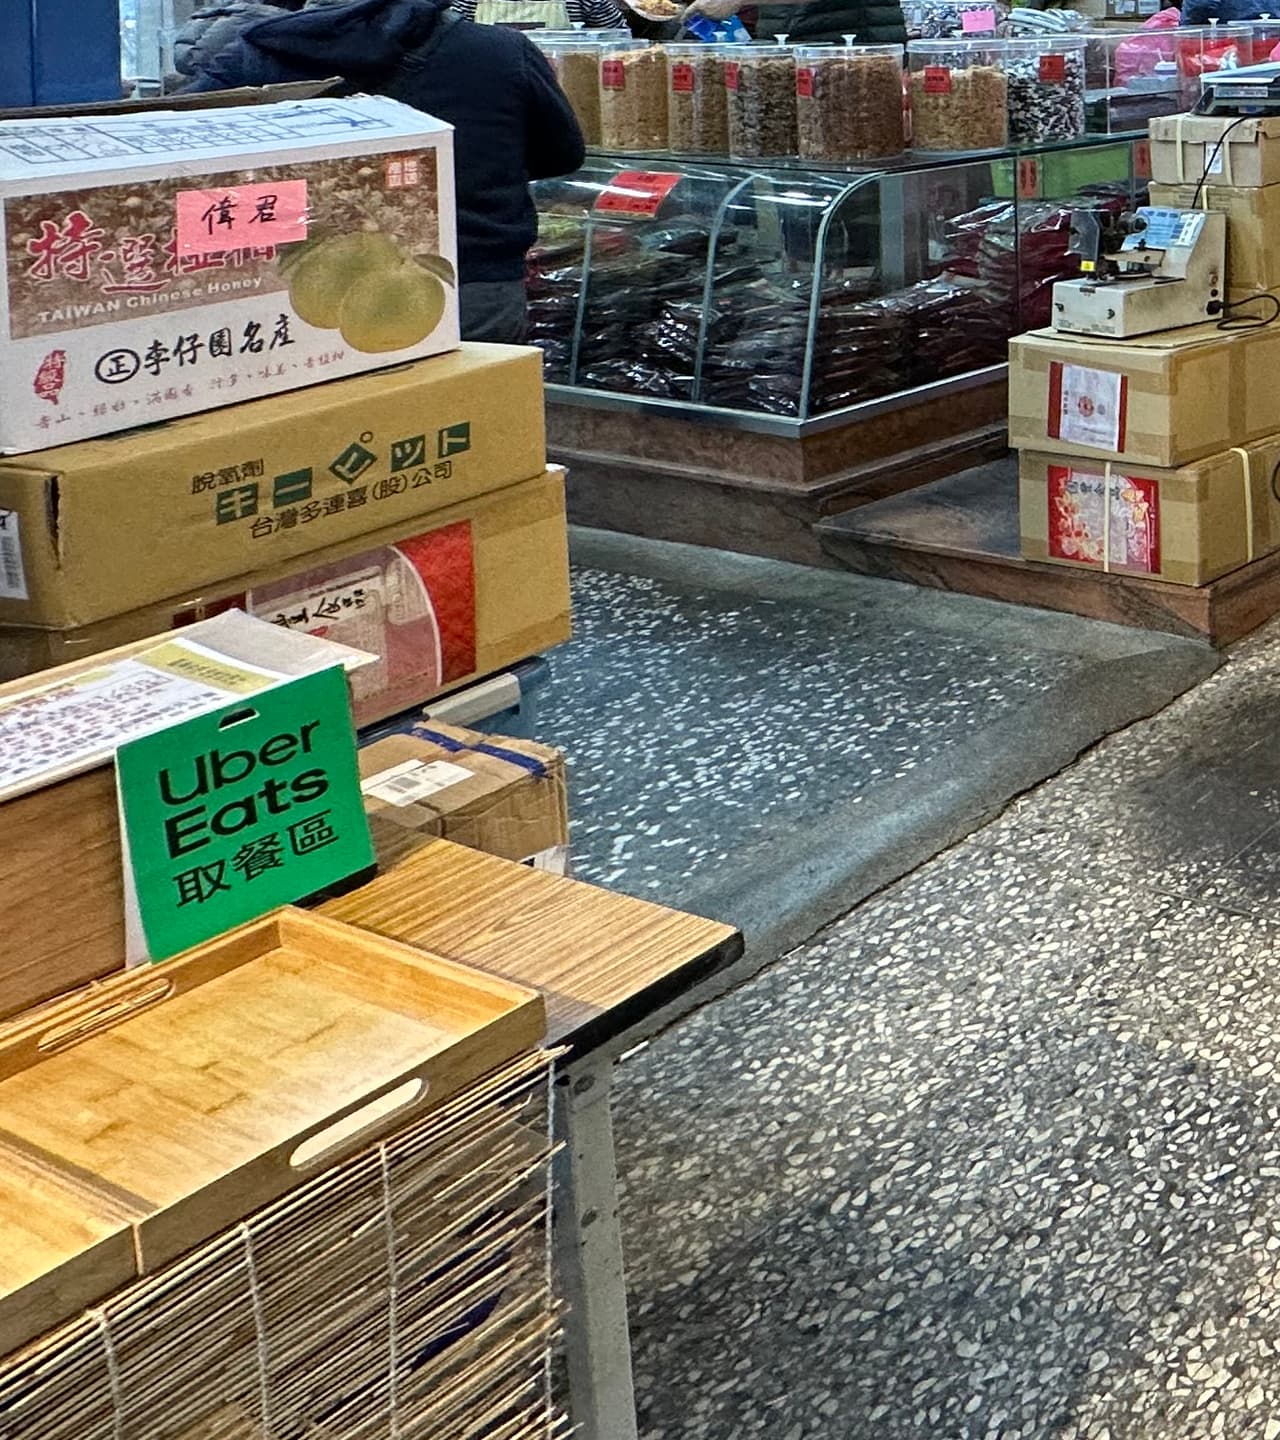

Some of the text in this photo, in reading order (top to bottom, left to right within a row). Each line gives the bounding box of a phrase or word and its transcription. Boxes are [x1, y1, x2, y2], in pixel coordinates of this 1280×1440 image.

[38, 276, 263, 323] TAIWAN Chinese Honey
[158, 719, 321, 806] Uber
[164, 767, 330, 860] Eats
[172, 808, 340, 909] 取餐區
